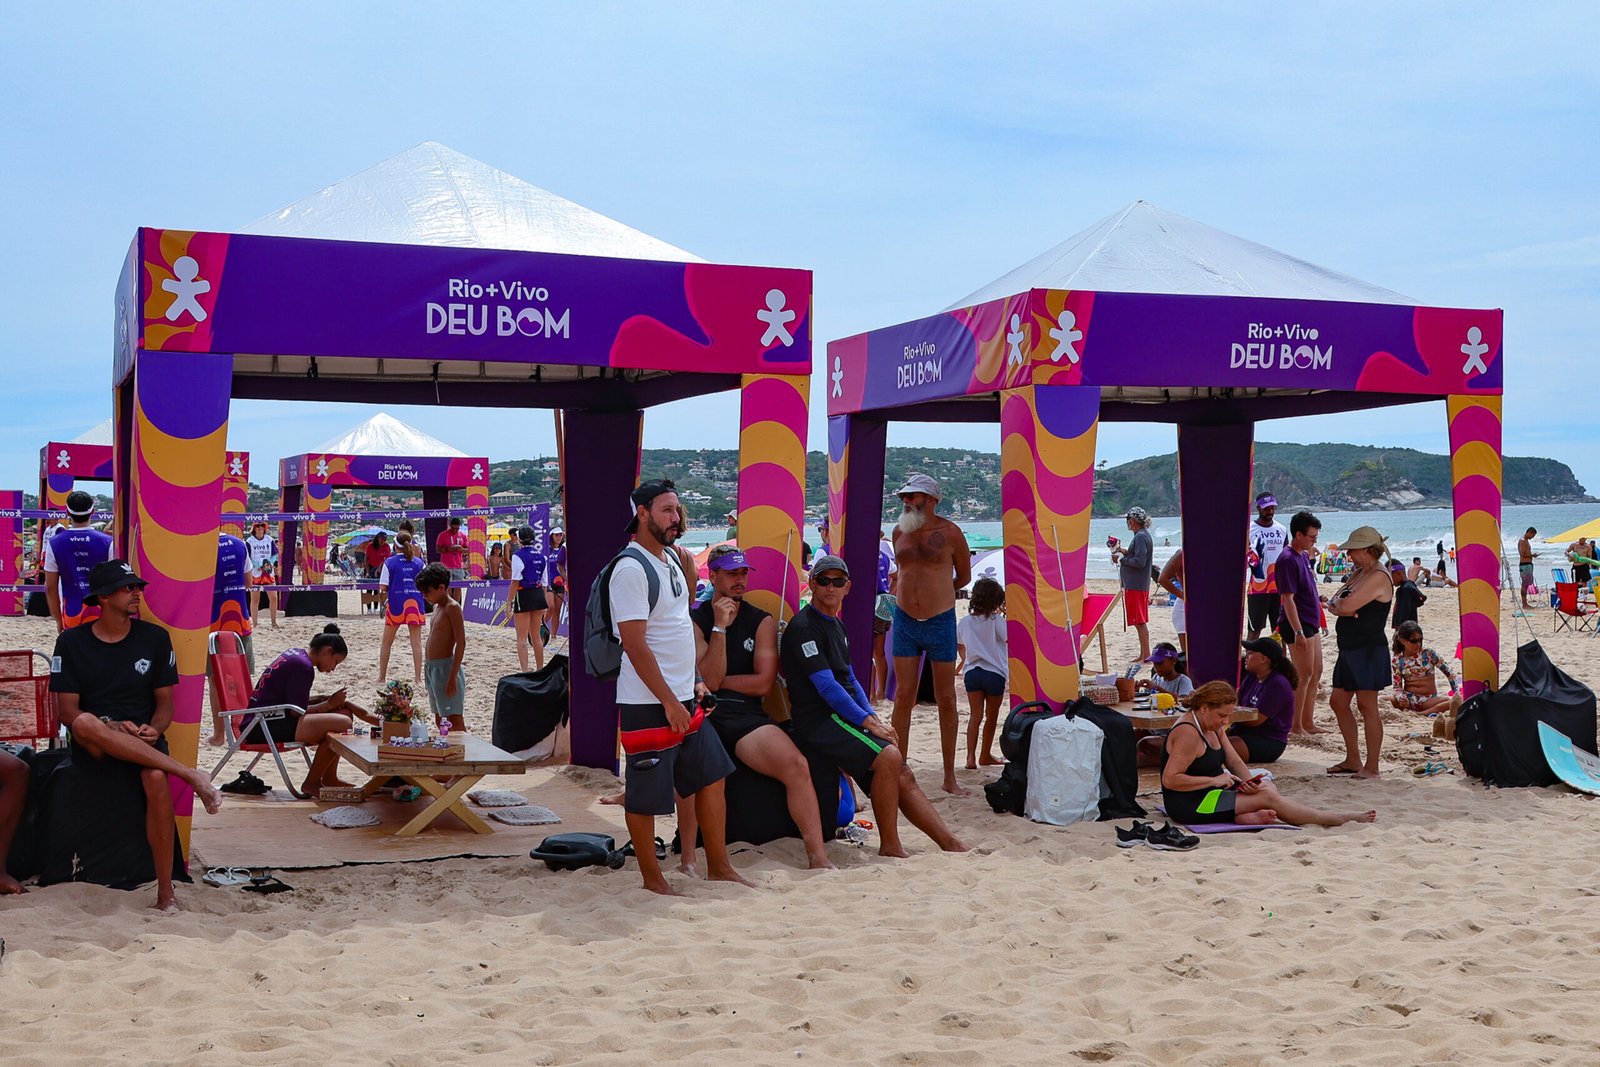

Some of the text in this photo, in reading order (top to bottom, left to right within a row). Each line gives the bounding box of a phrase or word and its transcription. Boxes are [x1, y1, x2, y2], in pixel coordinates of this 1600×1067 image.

[448, 278, 549, 302] Rio+Vivo
[426, 302, 570, 339] DEU BOM
[1248, 322, 1319, 341] Rio+Vivo
[903, 341, 936, 361] Rio+Vivo
[1230, 343, 1333, 370] DEU BOM
[897, 356, 942, 389] DEU BOM
[378, 470, 418, 480] DEU BOM
[48, 511, 66, 519] vivo
[338, 512, 356, 520] vivo
[429, 509, 446, 518] vivo
[473, 508, 489, 516] vivo
[534, 519, 547, 552] vivo
